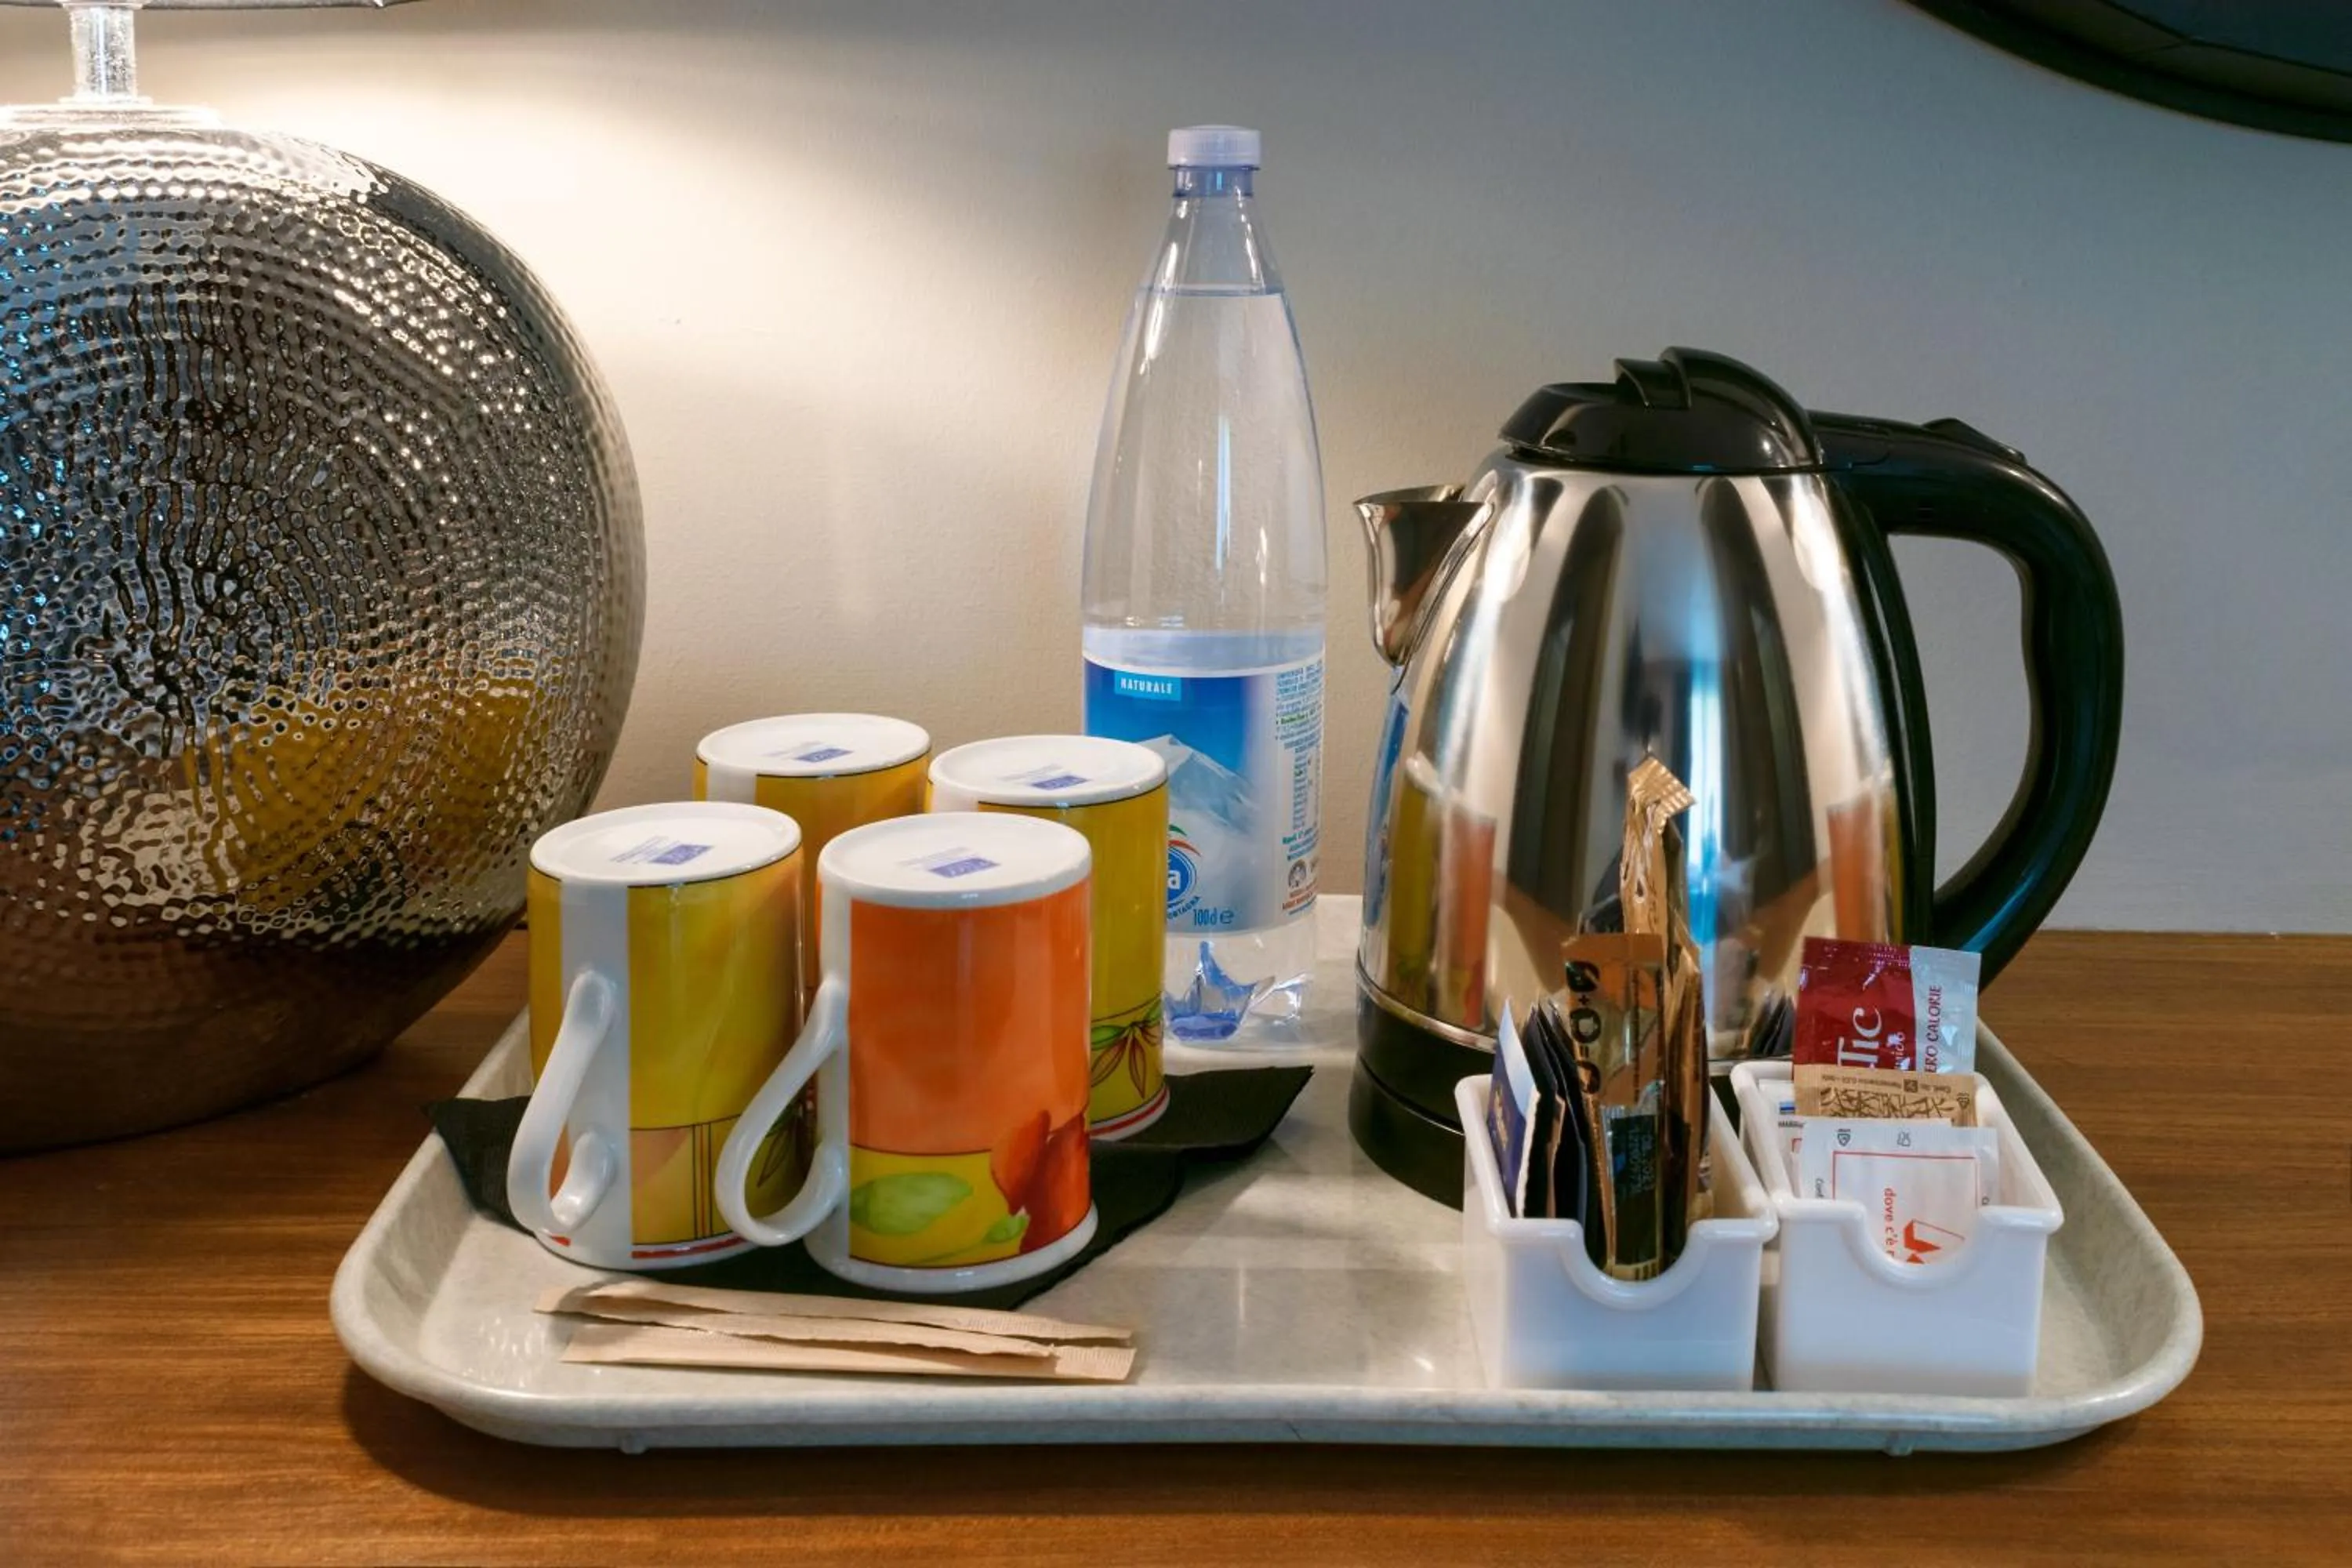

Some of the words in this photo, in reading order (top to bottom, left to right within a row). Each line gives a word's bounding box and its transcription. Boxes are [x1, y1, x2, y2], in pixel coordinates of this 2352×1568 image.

[1120, 677, 1173, 695] NATURALE
[1927, 984, 1942, 1042] CALORIE
[1925, 1045, 1938, 1073] ERO
[1884, 1188, 1896, 1222] dove
